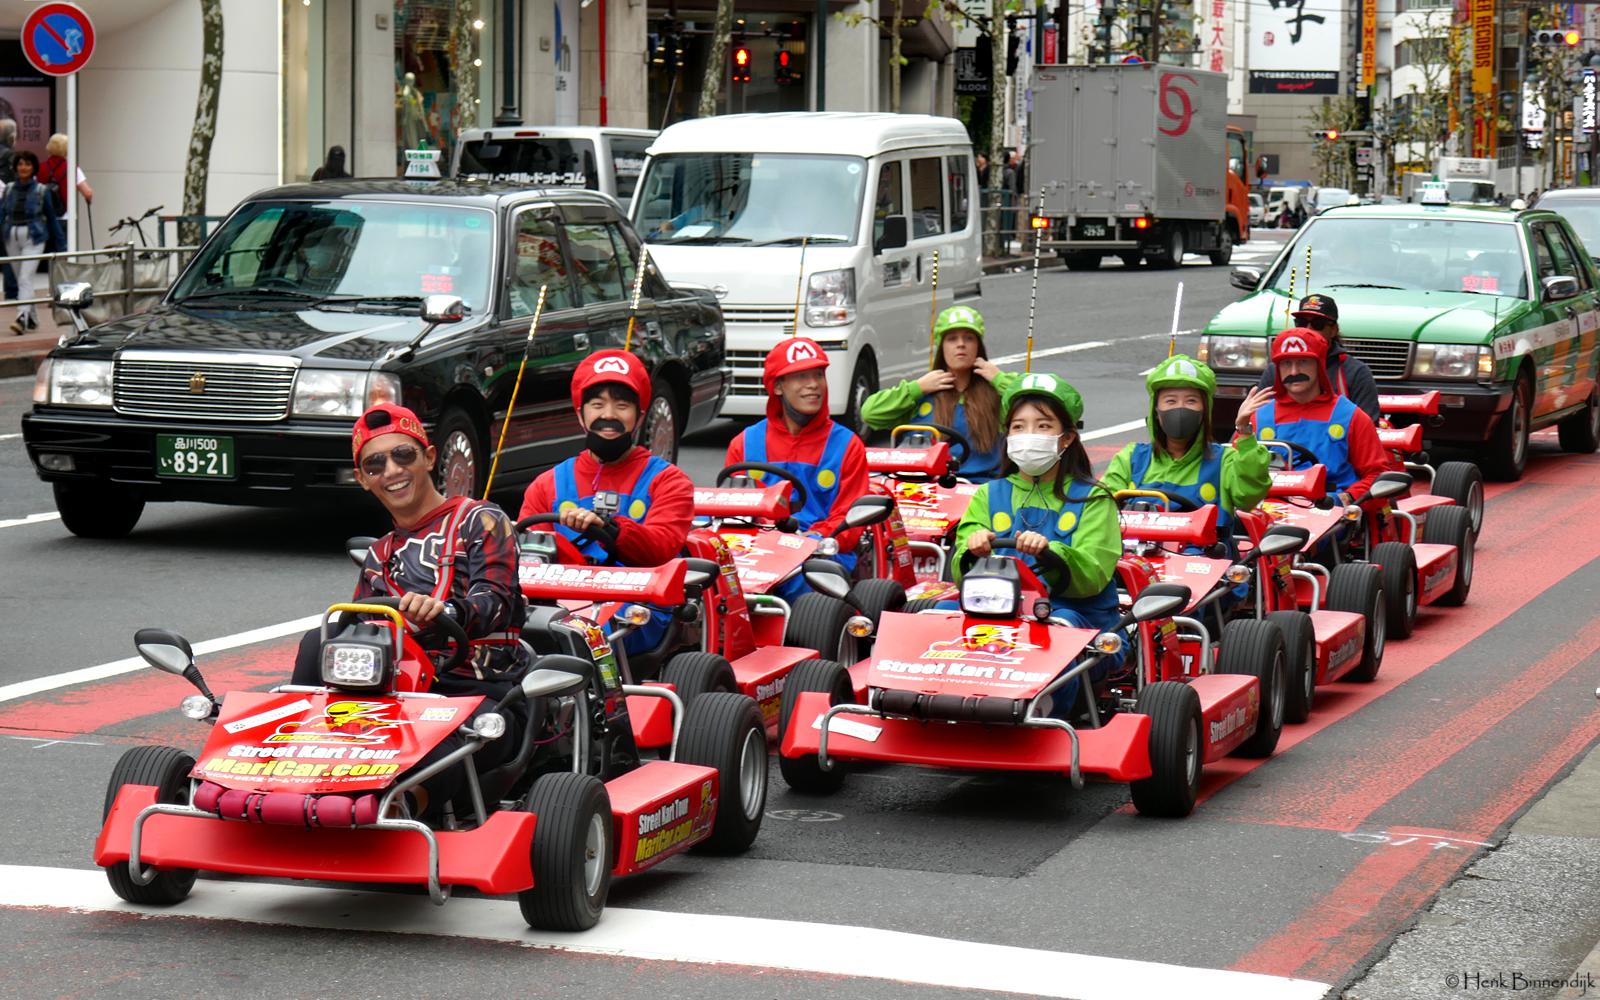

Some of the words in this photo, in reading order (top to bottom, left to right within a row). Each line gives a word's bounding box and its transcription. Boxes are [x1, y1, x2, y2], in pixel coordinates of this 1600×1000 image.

[1476, 15, 1491, 67] RECORDS
[198, 438, 217, 450] 500
[174, 451, 228, 475] 89-21
[1147, 513, 1191, 527] Tour
[876, 660, 945, 674] Street
[947, 663, 996, 679] Kart
[999, 667, 1051, 682] Tour
[227, 745, 294, 758] Street
[296, 746, 346, 759] Kart
[347, 747, 401, 760] Tour
[203, 758, 401, 777] MariCar.com
[639, 809, 661, 835] Street
[661, 802, 675, 827] Kart
[635, 819, 693, 863] MariCar.com
